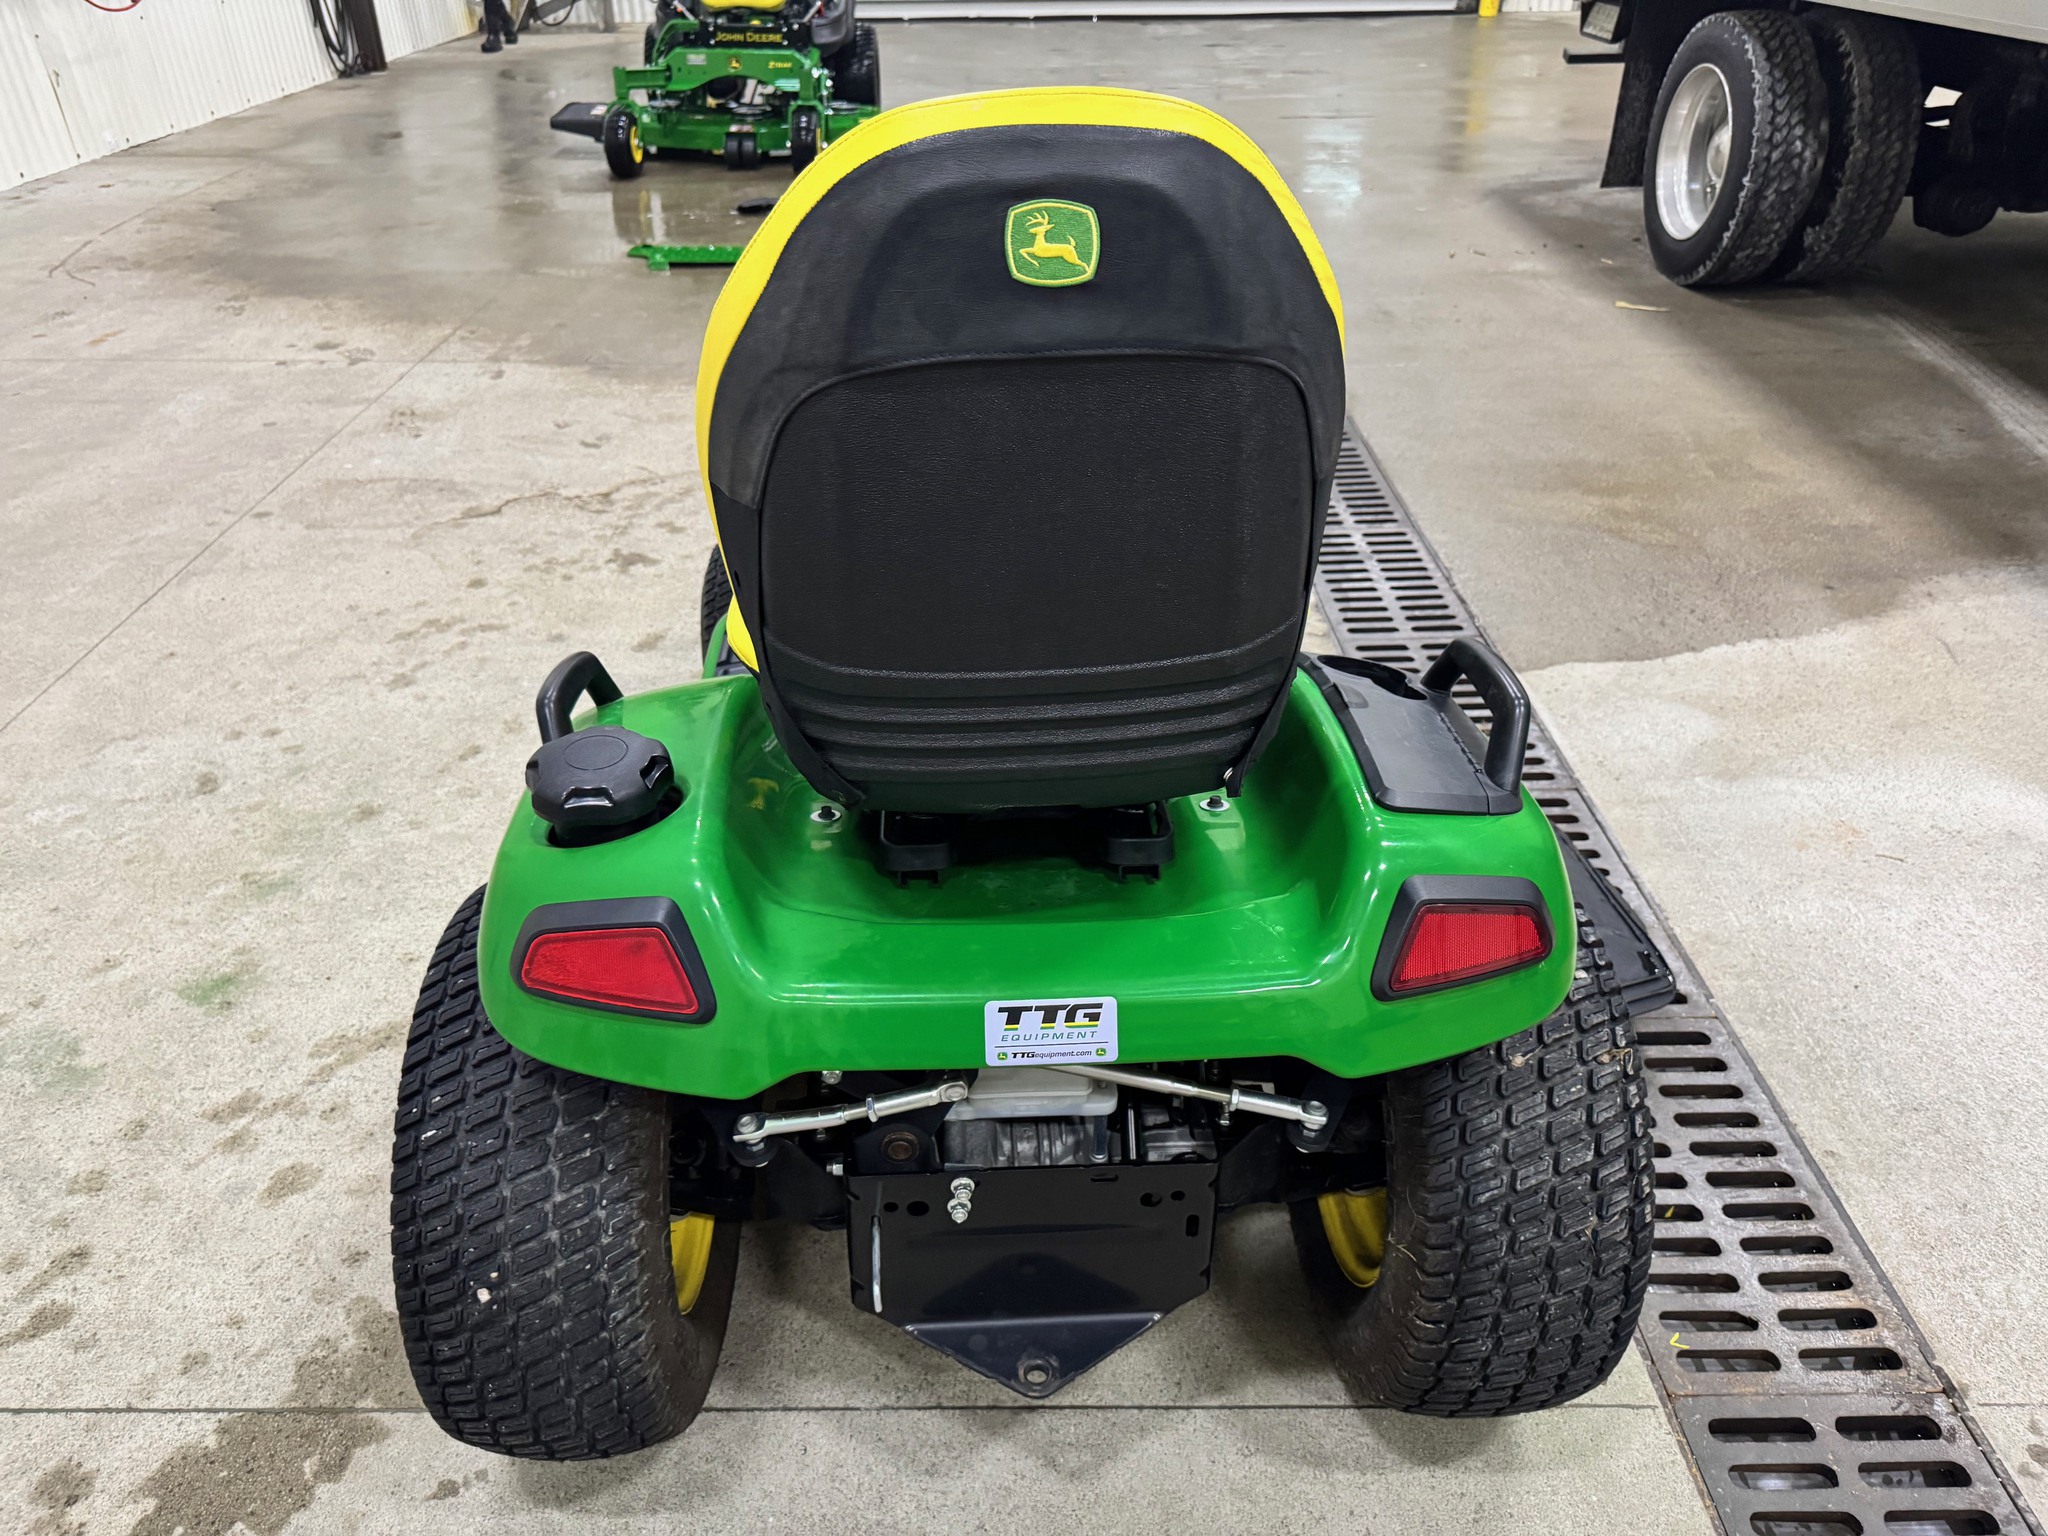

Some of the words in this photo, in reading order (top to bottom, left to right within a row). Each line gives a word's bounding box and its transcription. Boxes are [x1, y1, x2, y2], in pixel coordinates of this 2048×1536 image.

[715, 31, 745, 42] JOHN
[746, 32, 783, 43] DEERE
[997, 1002, 1103, 1031] TTG
[1001, 1031, 1097, 1042] EQUIPMENT
[1011, 1050, 1092, 1060] TTGequipment.com
